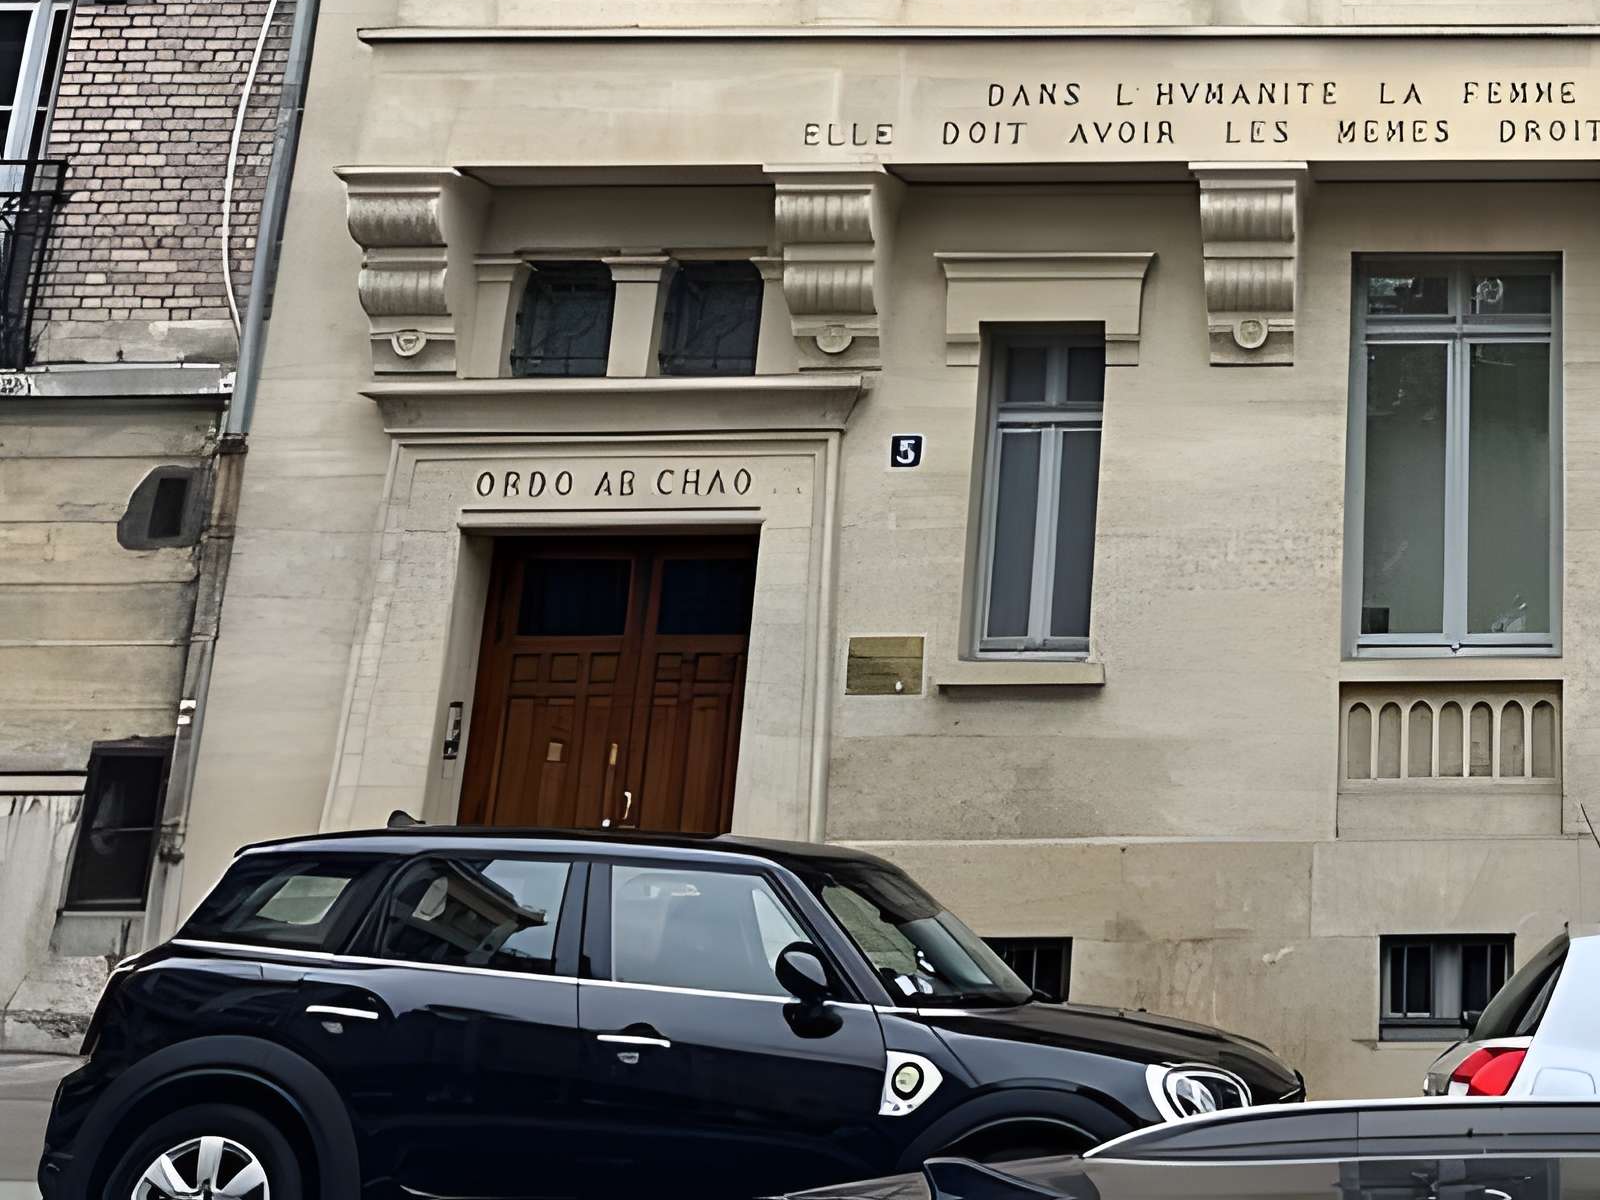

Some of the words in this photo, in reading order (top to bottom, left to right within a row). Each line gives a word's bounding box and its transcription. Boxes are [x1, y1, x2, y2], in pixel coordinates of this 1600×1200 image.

[987, 82, 1081, 107] DANS
[1379, 82, 1423, 105] LA
[1463, 81, 1576, 105] FEMME
[804, 122, 894, 147] ELLE
[942, 120, 1028, 146] DOIT
[1068, 120, 1175, 145] AVOIR
[1225, 120, 1289, 144] LES
[1337, 119, 1449, 145] MEMES
[896, 439, 916, 464] 5
[476, 470, 573, 498] ORDO
[593, 469, 636, 497] AB
[656, 467, 752, 497] CHAO
